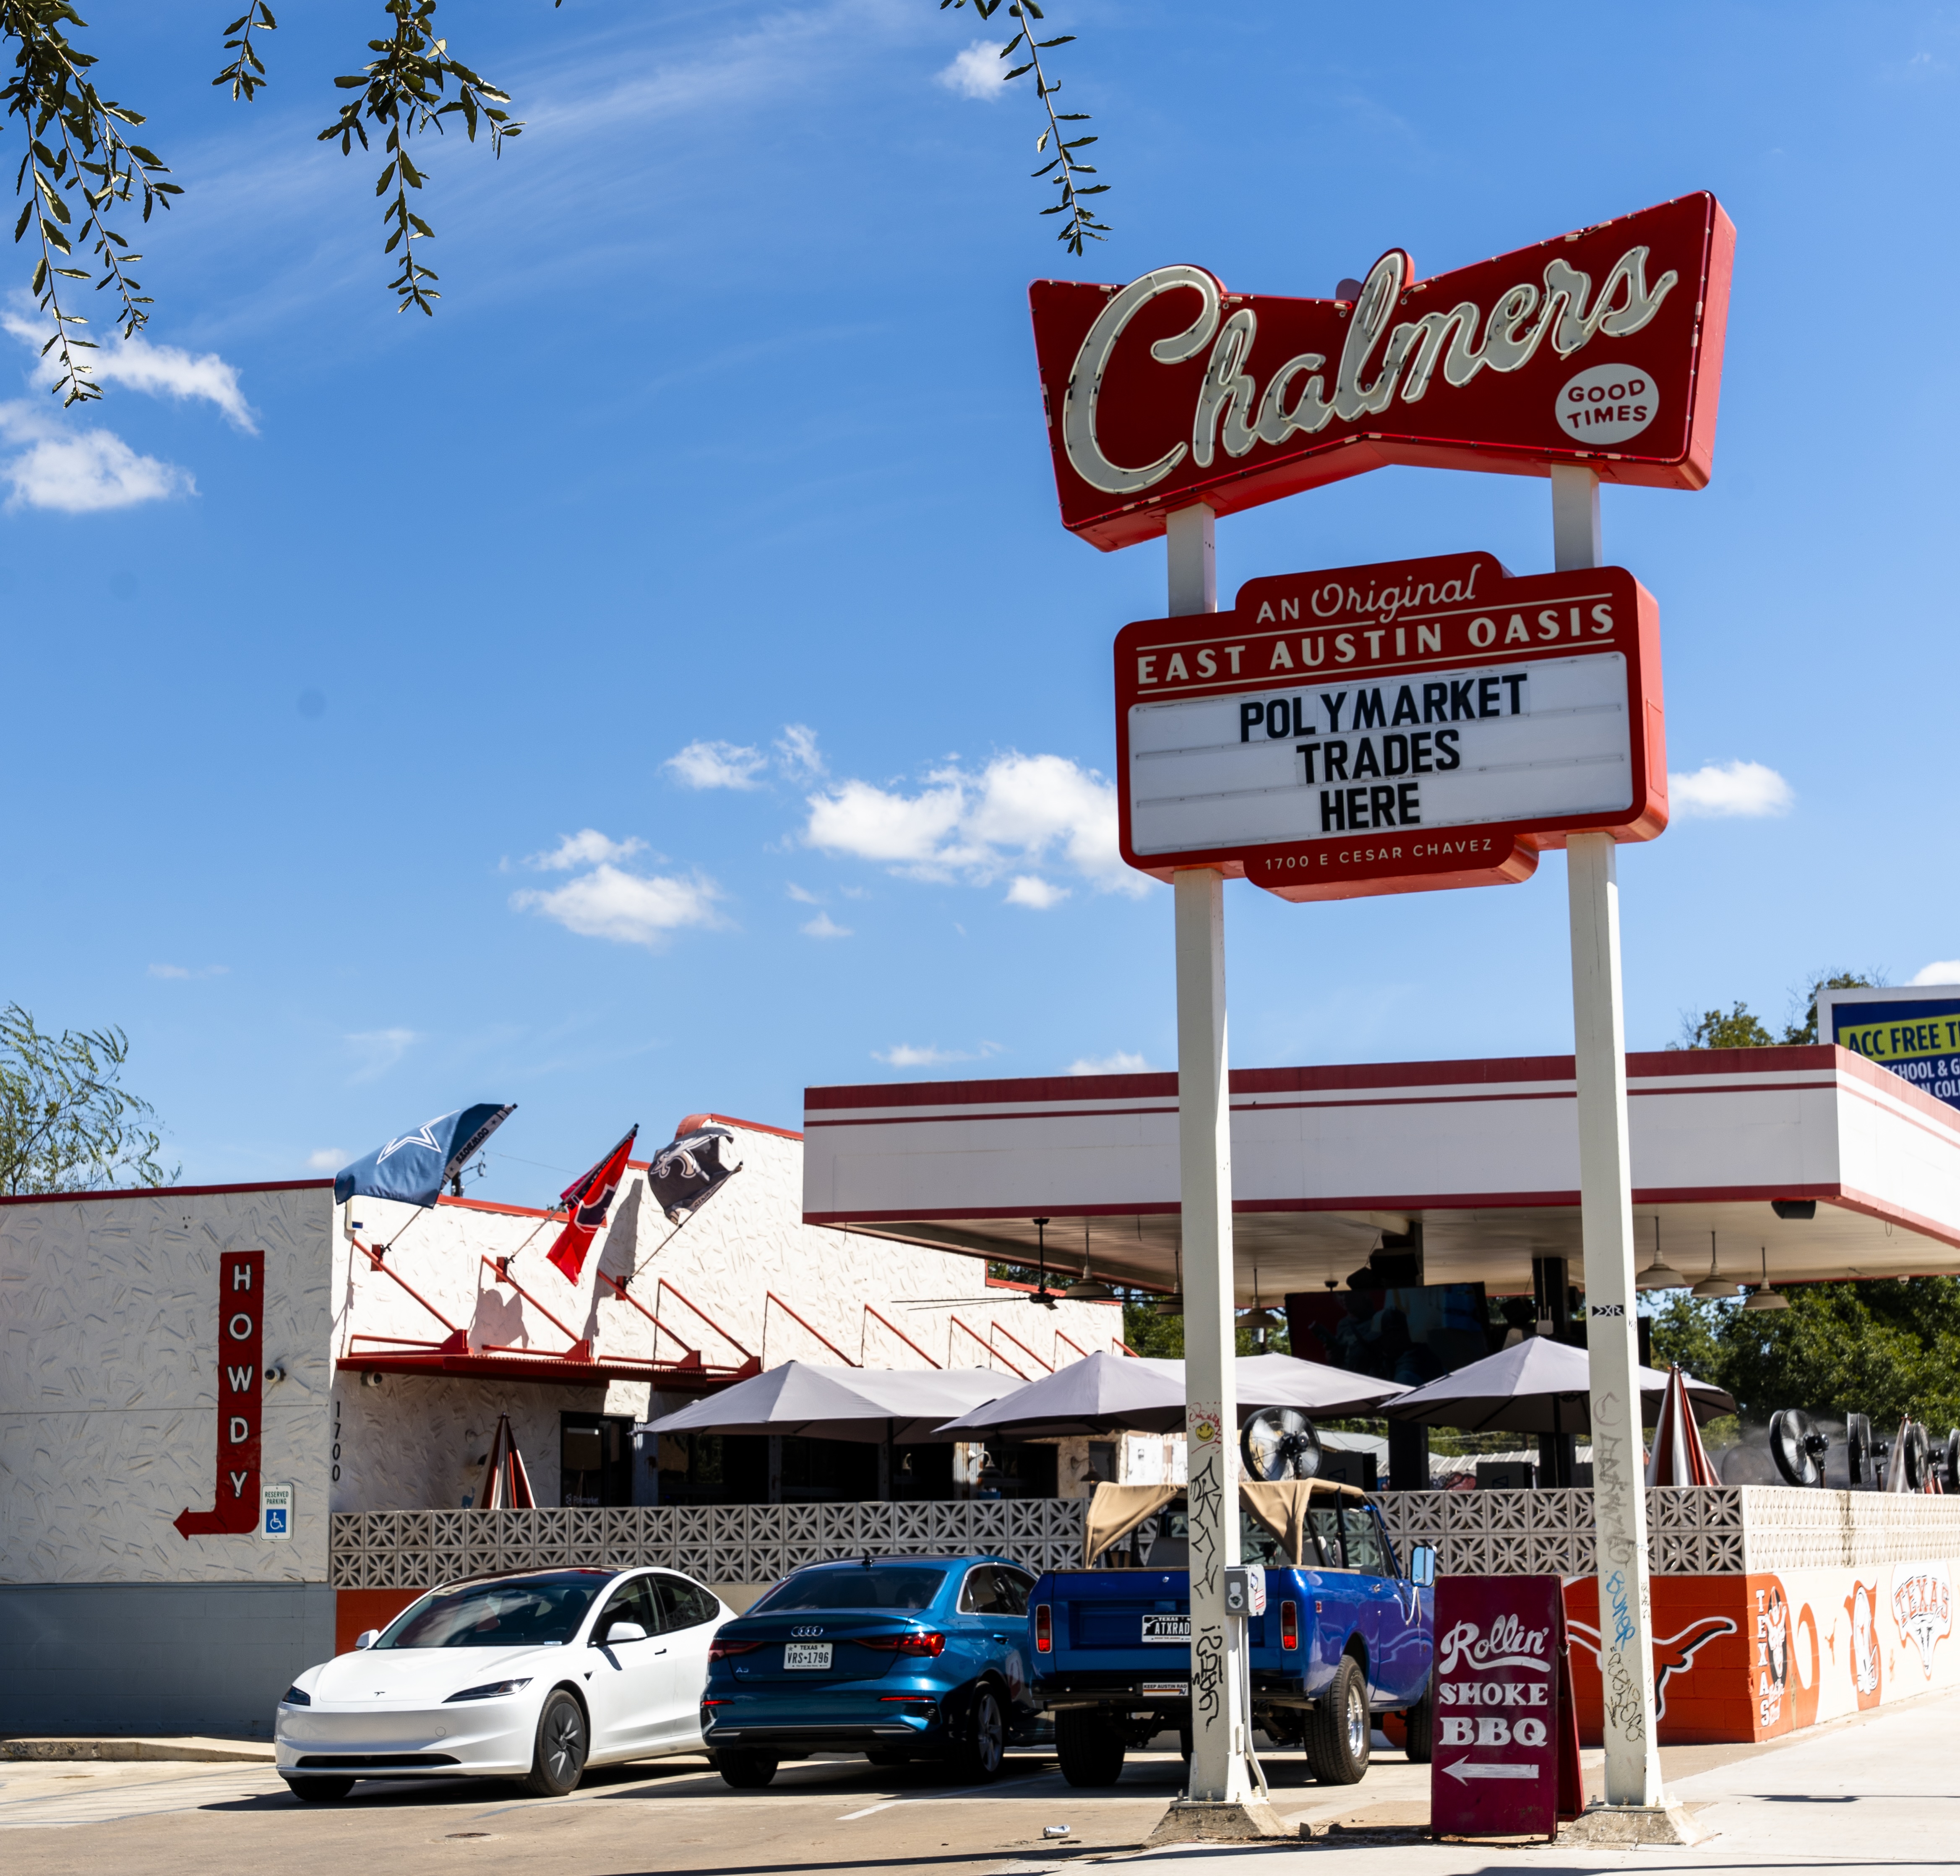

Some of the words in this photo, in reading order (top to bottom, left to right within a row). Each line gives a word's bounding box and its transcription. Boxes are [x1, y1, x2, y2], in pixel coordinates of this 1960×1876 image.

[1063, 246, 1679, 494] Chalmers
[1567, 378, 1646, 403] GOOD
[1566, 405, 1647, 429] TIMES
[1256, 598, 1299, 623] AN
[1311, 563, 1481, 623] Original
[1138, 645, 1246, 685] EAST
[1269, 623, 1442, 670] AUSTIN
[1468, 603, 1614, 647] OASIS
[1240, 673, 1527, 743] POLYMARKET
[1296, 730, 1460, 784] TRADES
[1320, 783, 1420, 832] HERE
[1265, 856, 1309, 870] 1700
[1320, 854, 1328, 865] E
[1340, 847, 1403, 864] CESAR
[1413, 839, 1493, 856] CHAVEZ
[1849, 1029, 1885, 1056] ACC
[1890, 1024, 1941, 1054] FREE
[1945, 1021, 1960, 1048] T
[1884, 1061, 1935, 1081] HOOL
[1937, 1060, 1948, 1077] &
[1951, 1058, 1960, 1075] G
[1934, 1079, 1960, 1098] COL
[455, 1127, 490, 1164] COWBOYS
[228, 1264, 252, 1498] HOWDY
[332, 1401, 341, 1482] 1700
[1895, 1575, 1949, 1628] TEXAS
[1155, 1622, 1190, 1634] ATXRAD
[1439, 1613, 1551, 1674] Rollin'
[1756, 1589, 1770, 1727] TEXAS
[1439, 1683, 1548, 1706] SMOKE
[1439, 1717, 1548, 1747] BBQ
